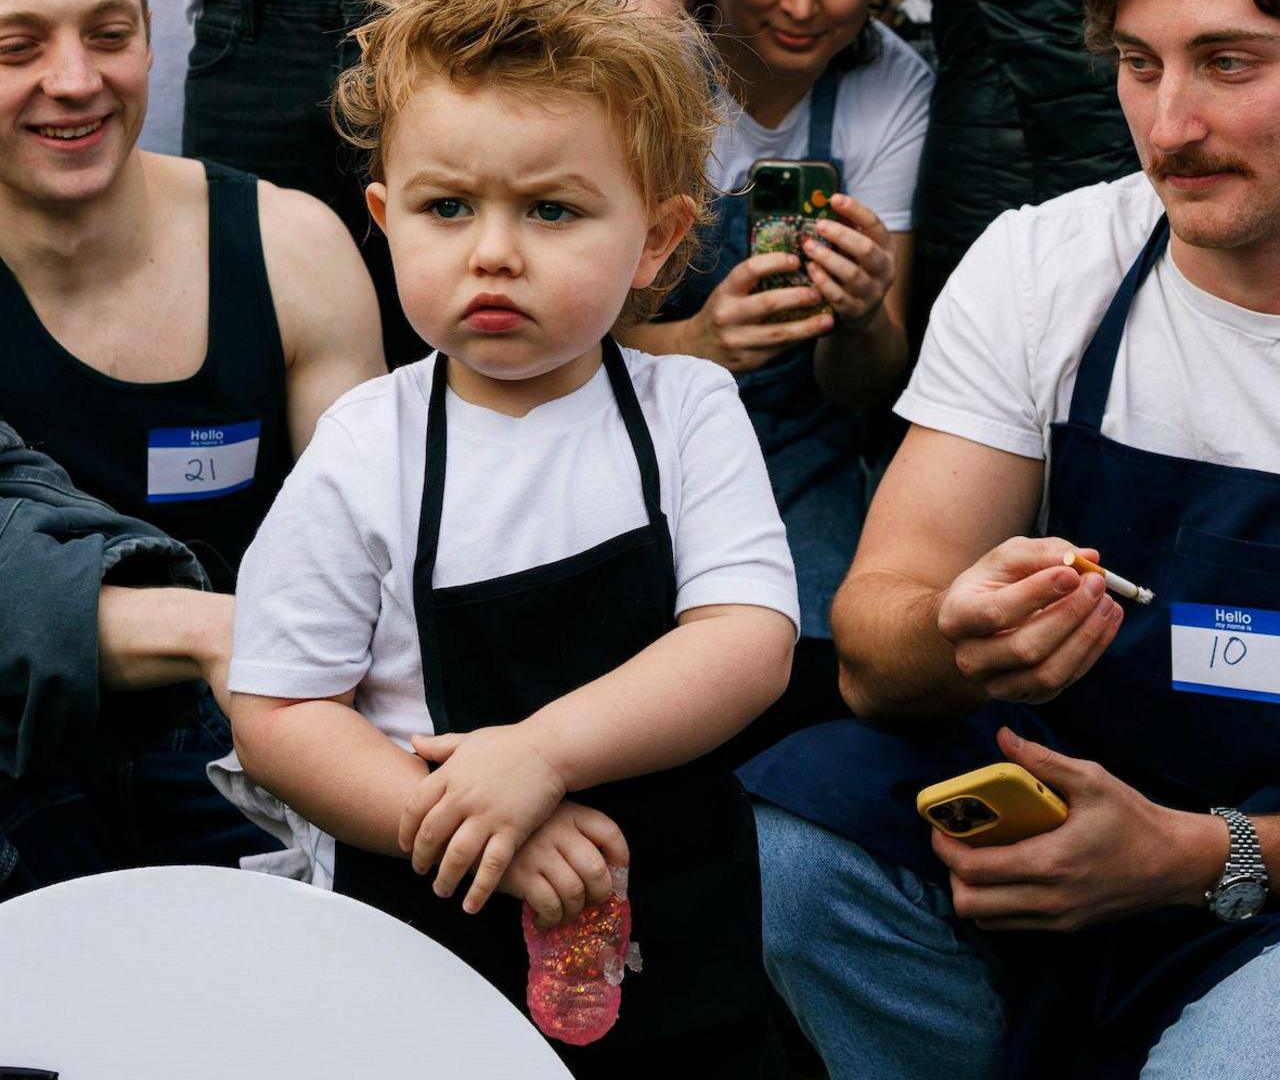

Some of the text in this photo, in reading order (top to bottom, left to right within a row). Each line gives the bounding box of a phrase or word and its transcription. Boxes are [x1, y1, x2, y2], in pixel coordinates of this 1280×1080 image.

[190, 430, 224, 441] Hello
[184, 458, 216, 482] 21
[1215, 609, 1252, 625] Hello
[1209, 635, 1247, 668] 10
